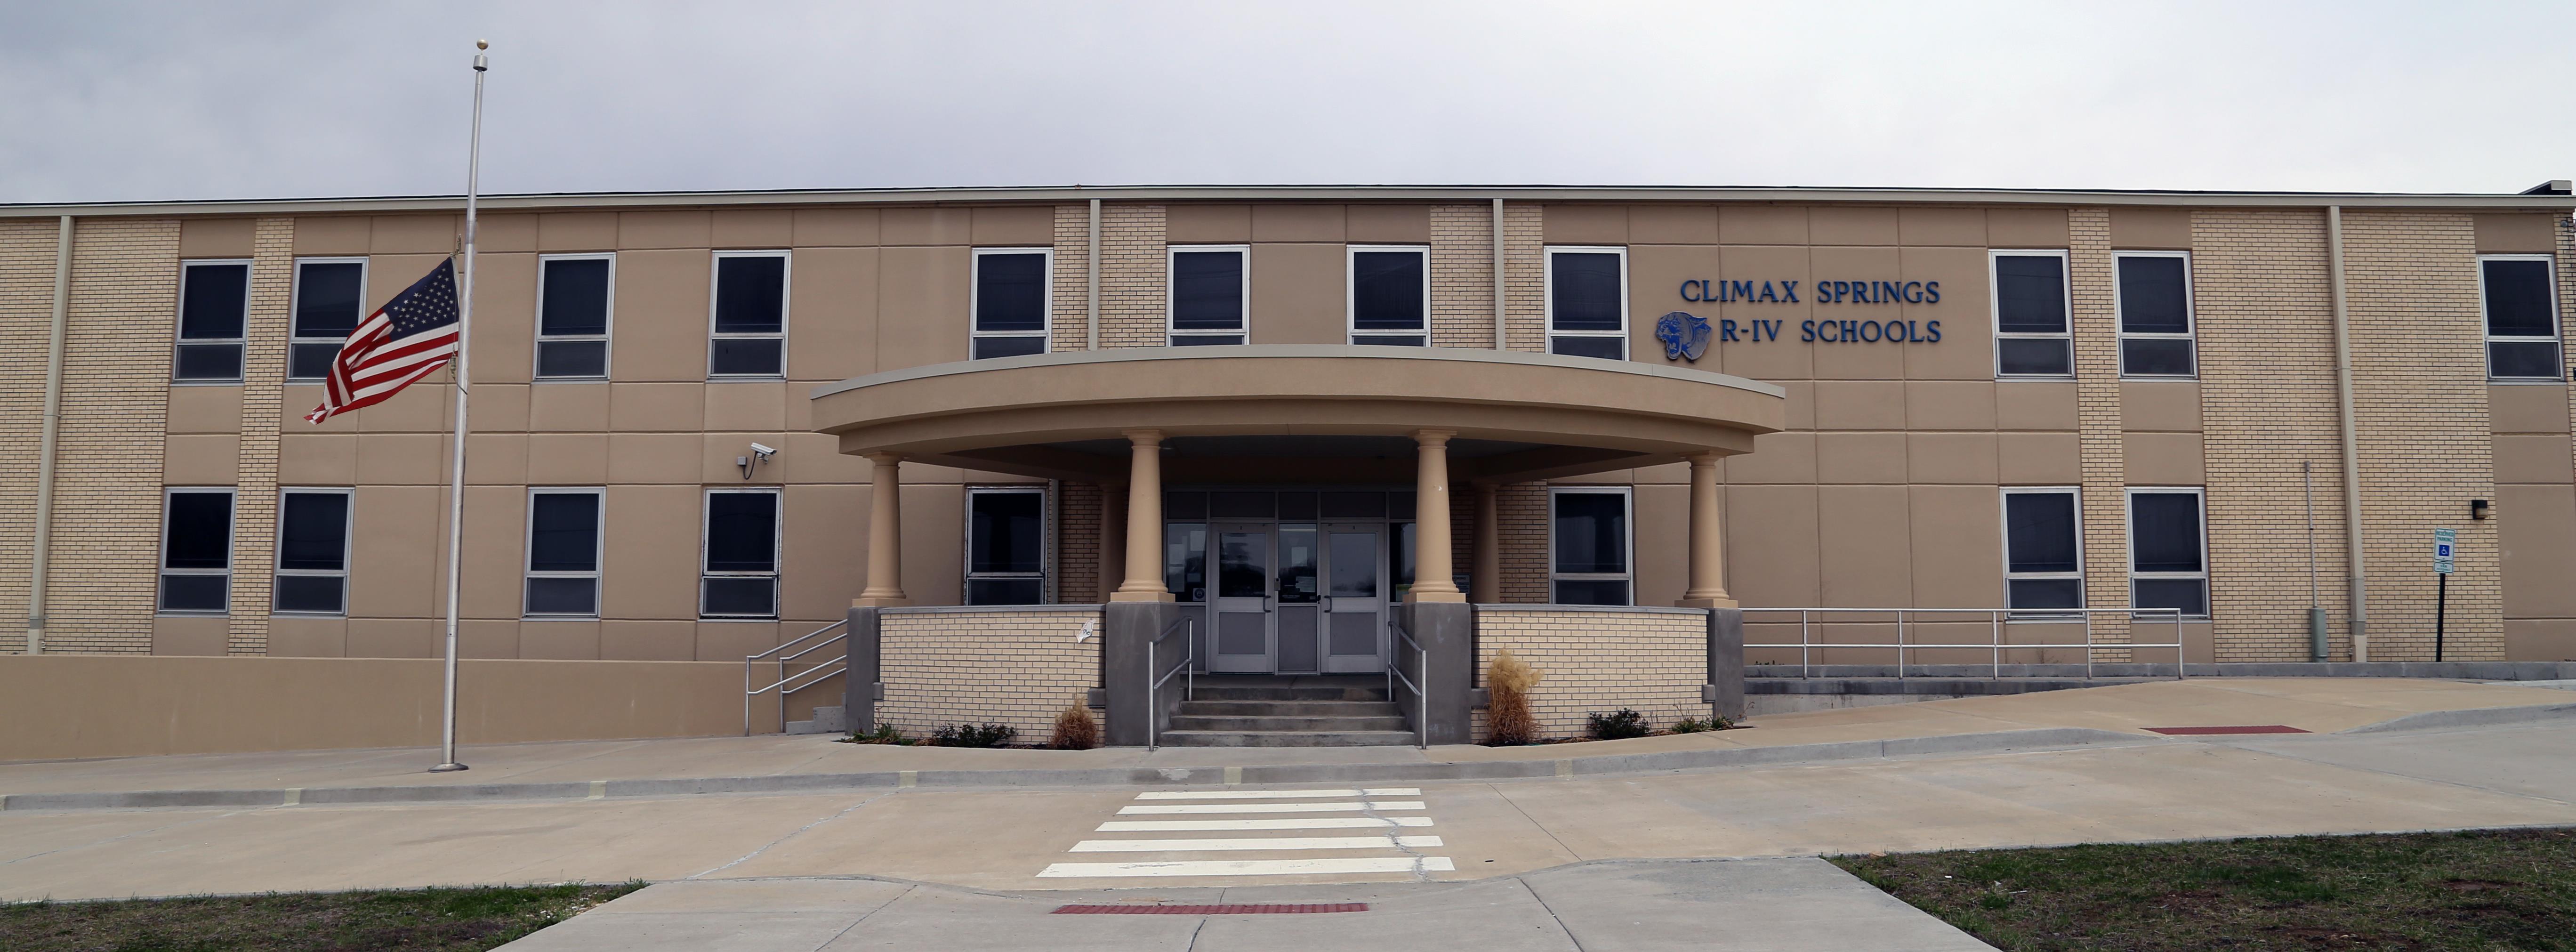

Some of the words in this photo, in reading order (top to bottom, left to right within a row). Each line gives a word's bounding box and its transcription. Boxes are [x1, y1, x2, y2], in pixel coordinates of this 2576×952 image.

[1680, 279, 1800, 303] CLIMAX
[1817, 280, 1941, 304] SPRINGS
[1721, 319, 1783, 342] R-IV
[1801, 319, 1942, 343] SCHOOLS
